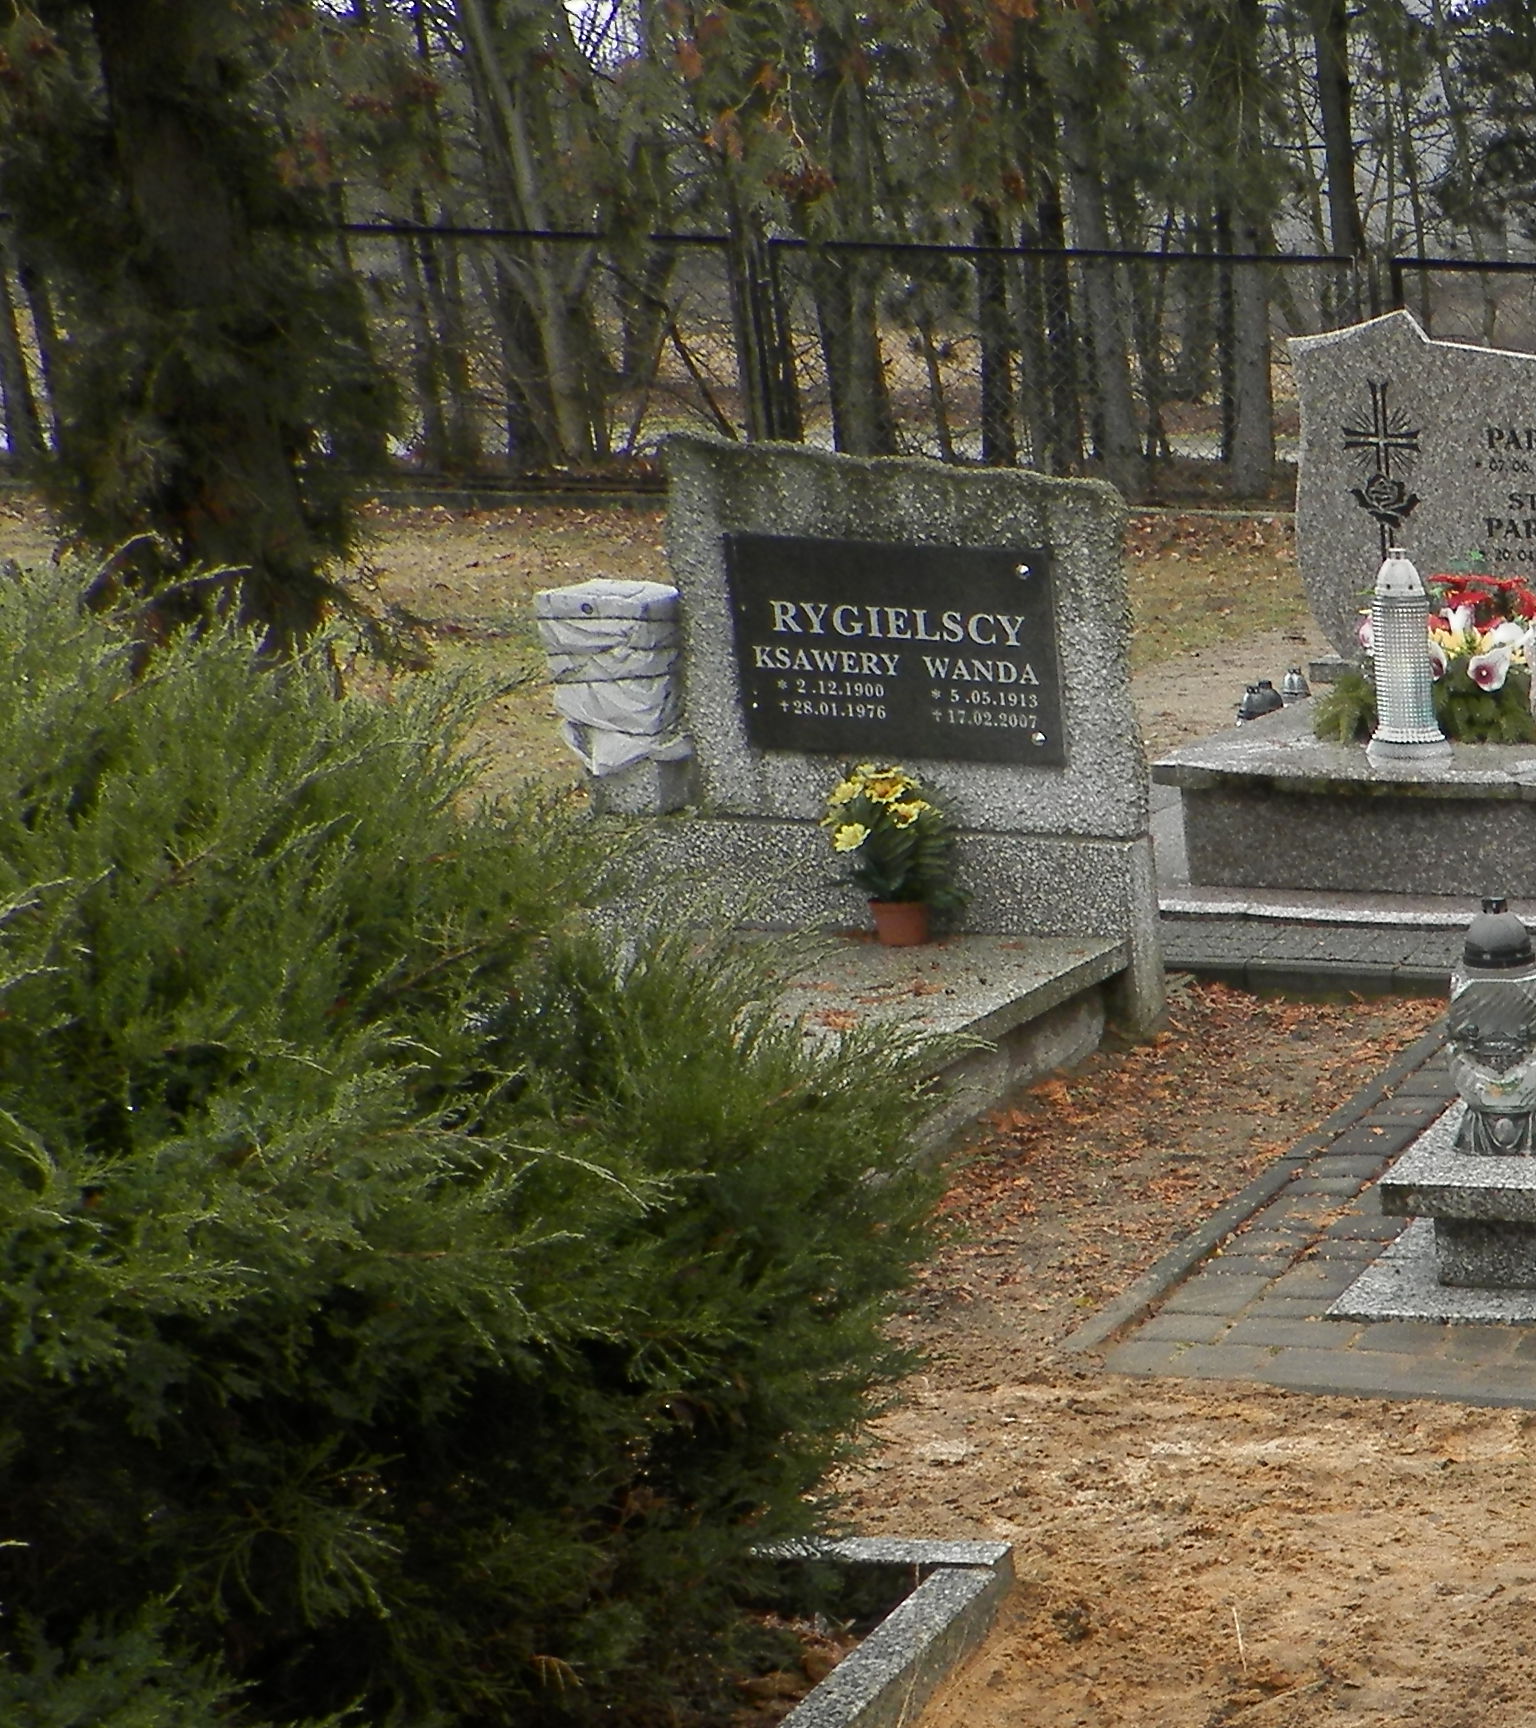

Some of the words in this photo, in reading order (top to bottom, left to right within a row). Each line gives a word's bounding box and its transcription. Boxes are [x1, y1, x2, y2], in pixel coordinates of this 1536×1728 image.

[769, 600, 1024, 646] RYGIELSCY
[752, 646, 900, 676] KSAWERY
[922, 656, 1039, 685] WANDA
